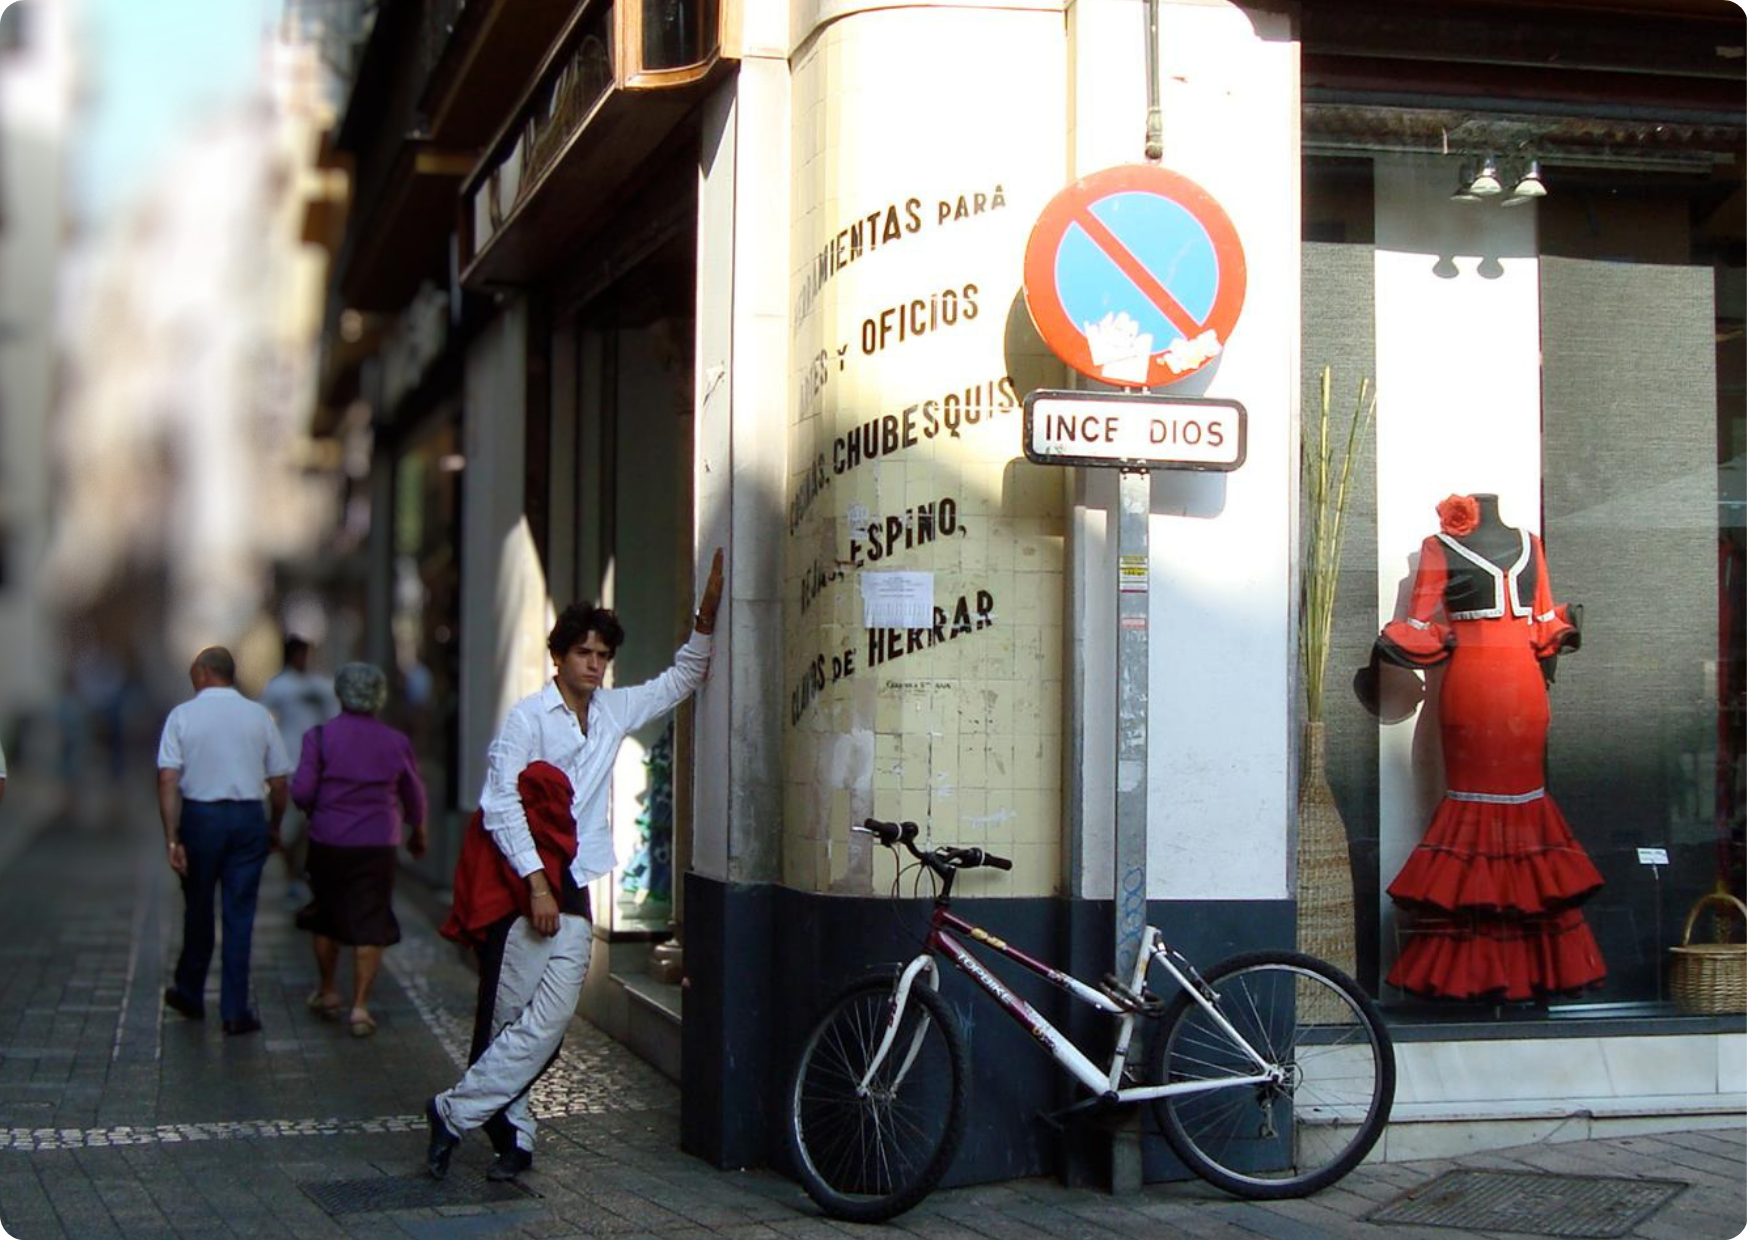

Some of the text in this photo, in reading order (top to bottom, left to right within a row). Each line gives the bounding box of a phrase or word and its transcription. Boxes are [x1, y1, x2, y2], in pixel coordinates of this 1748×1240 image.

[938, 184, 1007, 226] PARA
[862, 283, 979, 355] OFICIOS
[868, 590, 994, 667] HERRAR
